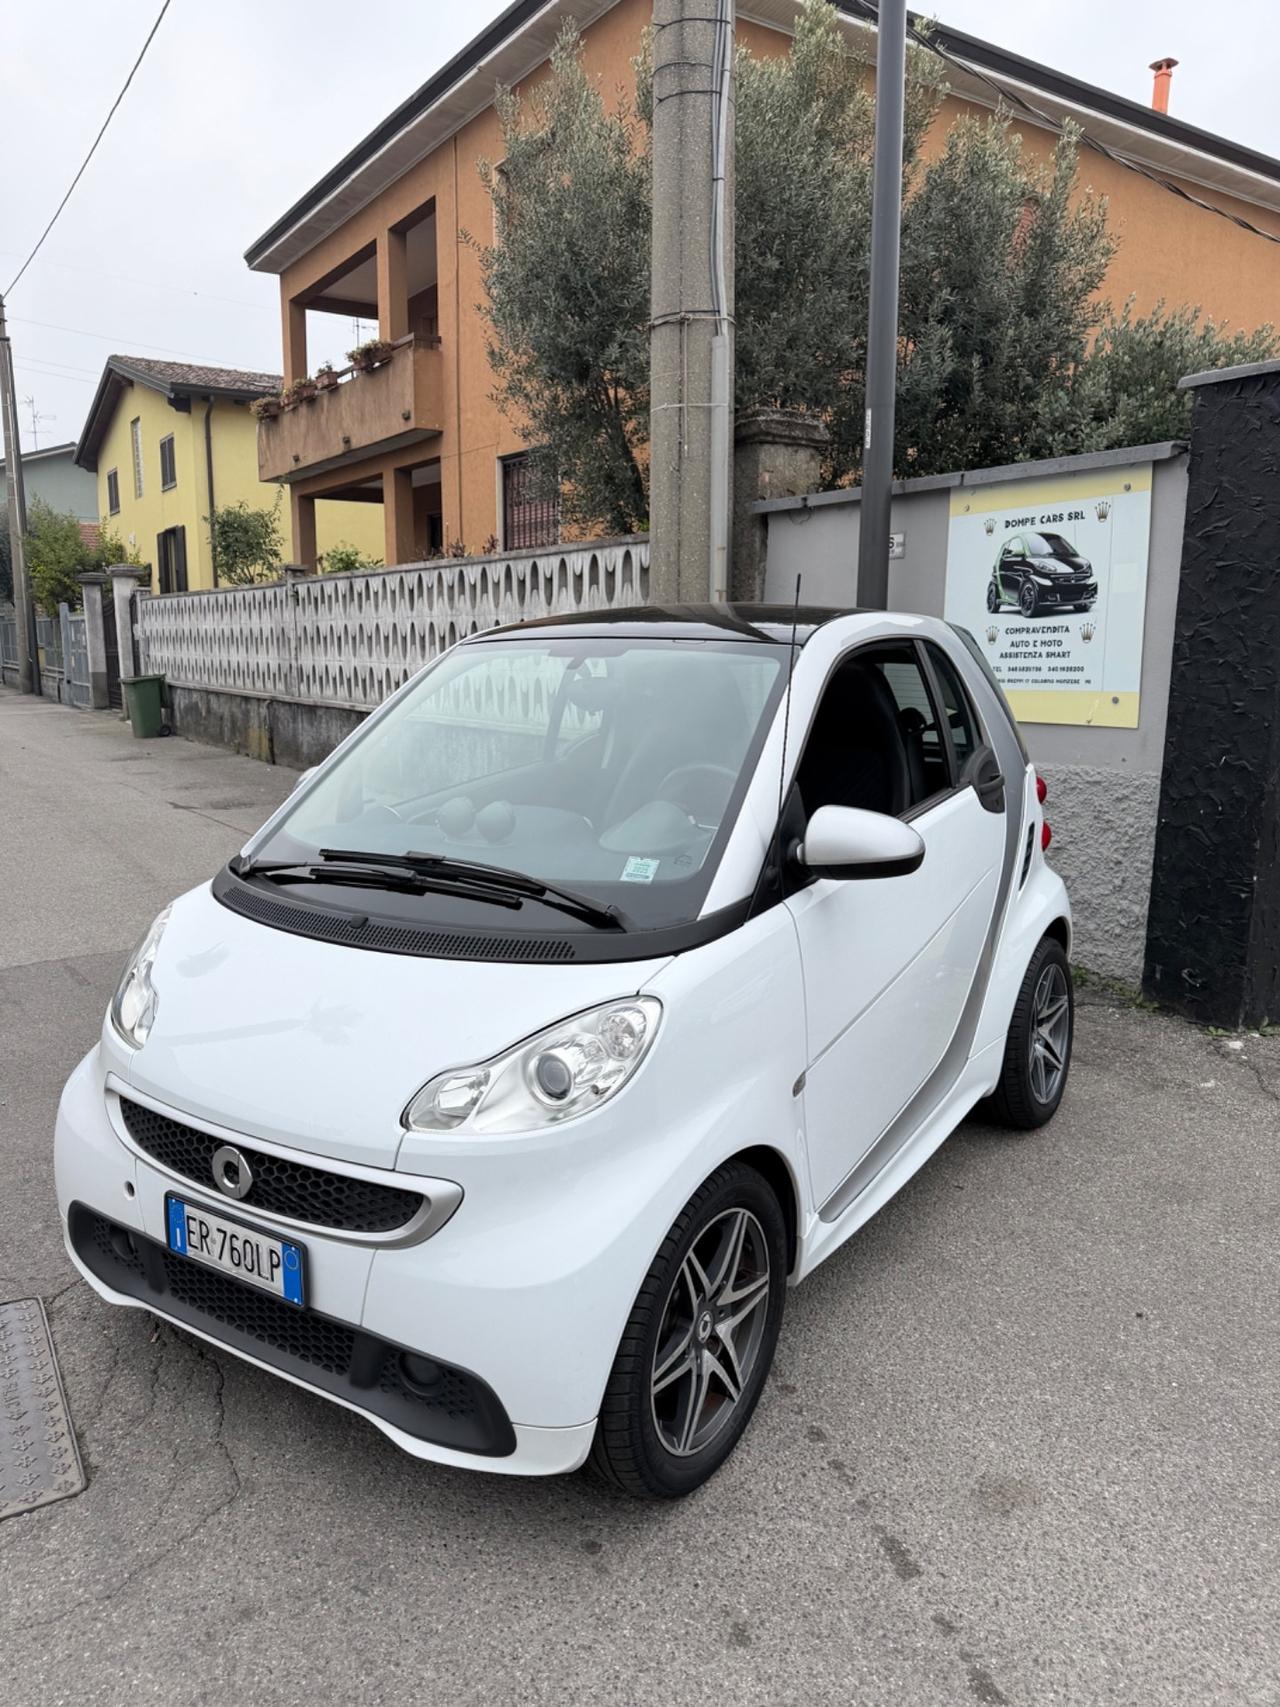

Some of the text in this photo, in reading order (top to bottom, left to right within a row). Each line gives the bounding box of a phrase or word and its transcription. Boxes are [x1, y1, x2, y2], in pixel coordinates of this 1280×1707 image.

[1005, 510, 1085, 529] DOMPE CARS SRL
[1005, 625, 1070, 635] COMPRAVENDITA
[1010, 640, 1063, 648] AUTO E MOTO
[999, 651, 1071, 659] ASSISTENZA SMART
